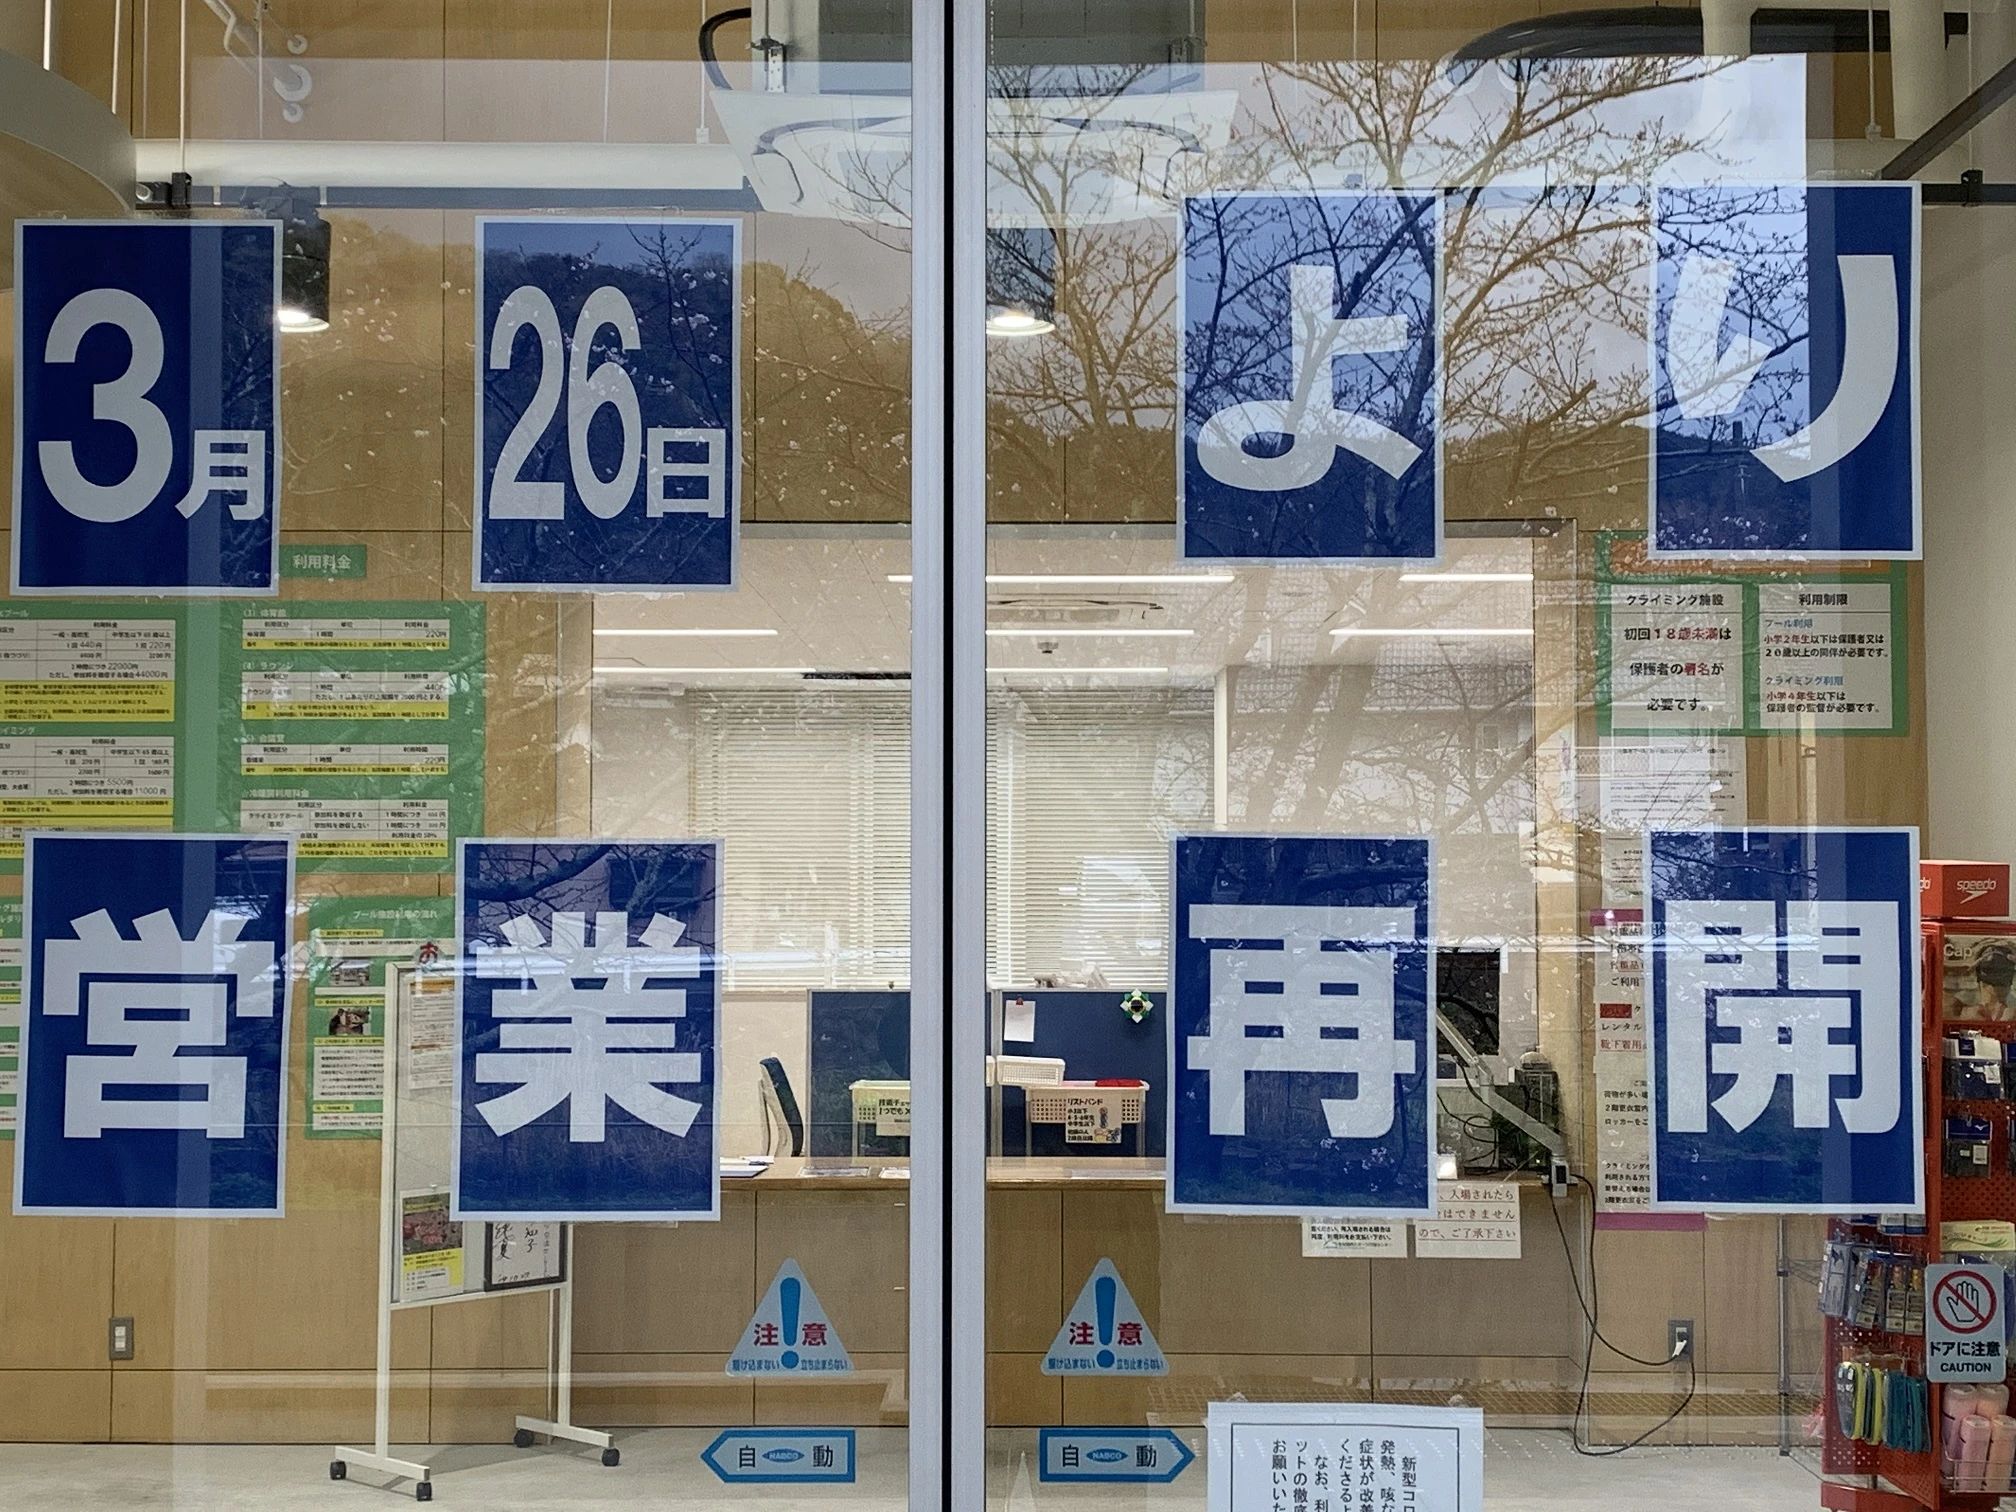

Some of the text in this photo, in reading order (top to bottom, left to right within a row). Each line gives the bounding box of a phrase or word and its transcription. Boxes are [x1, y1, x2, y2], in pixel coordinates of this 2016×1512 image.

[292, 553, 352, 569] 利用料金
[1626, 594, 1724, 606] クライミング施設
[1798, 593, 1849, 606] 利用制限
[1630, 662, 1724, 676] 保護者の署名が
[1646, 697, 1706, 711] 必要です。
[1956, 878, 1997, 892] speedo
[1943, 943, 1972, 962] Cap
[43, 907, 277, 1139] 営
[474, 911, 703, 1143] 業
[1187, 903, 1417, 1139] 再
[1665, 899, 1901, 1134] 開
[1418, 1228, 1516, 1239] ので、ご了承下さい
[1930, 1341, 2001, 1356] ドアに注意
[1940, 1362, 1992, 1373] CAUTION
